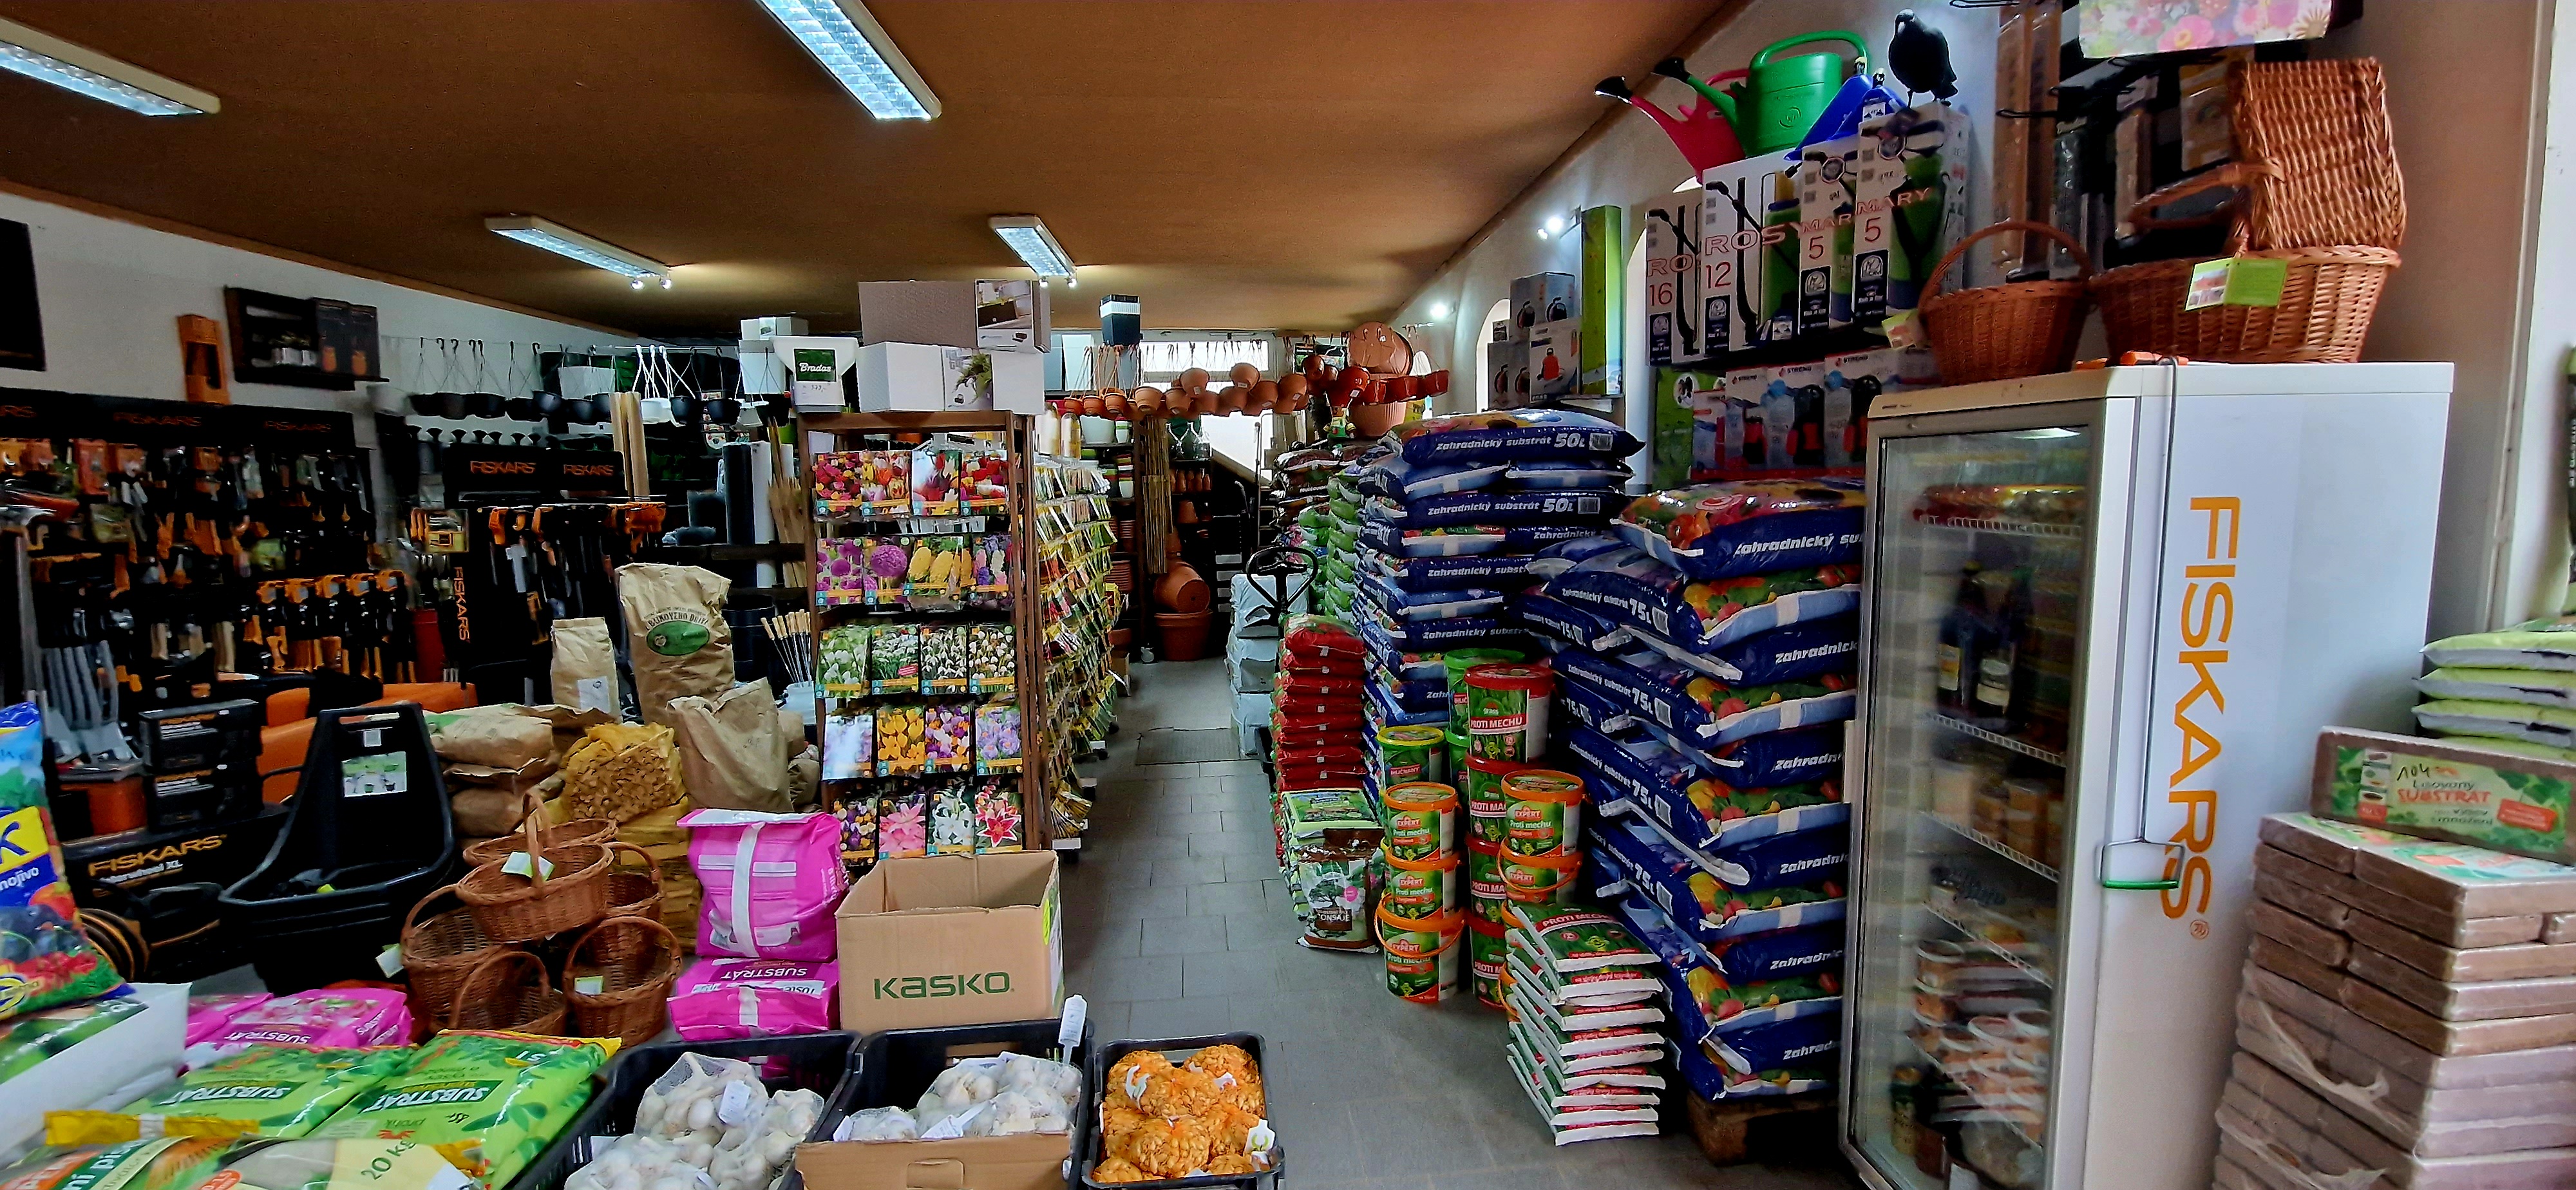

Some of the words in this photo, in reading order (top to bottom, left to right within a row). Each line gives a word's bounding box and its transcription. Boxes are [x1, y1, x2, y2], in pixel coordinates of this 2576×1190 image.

[1802, 214, 1852, 233] MAR
[1864, 217, 1881, 242] 5
[1808, 236, 1824, 260] 5
[1706, 261, 1732, 289] 12
[1649, 282, 1673, 307] 16
[799, 363, 831, 372] Bradas
[470, 460, 536, 475] FISKARS
[563, 464, 614, 476] FISKARS
[453, 566, 470, 641] FISKARS
[1775, 640, 1858, 665] Zahradnick
[2159, 496, 2241, 919] FISKARS
[1489, 716, 1523, 728] MECHU
[2396, 762, 2430, 781] 104
[1515, 809, 1540, 818] EXPERT
[88, 835, 223, 876] FISKARS
[1542, 914, 1575, 927] PROTI
[721, 968, 808, 981] SUBSTRÁT
[361, 1157, 392, 1180] 20
